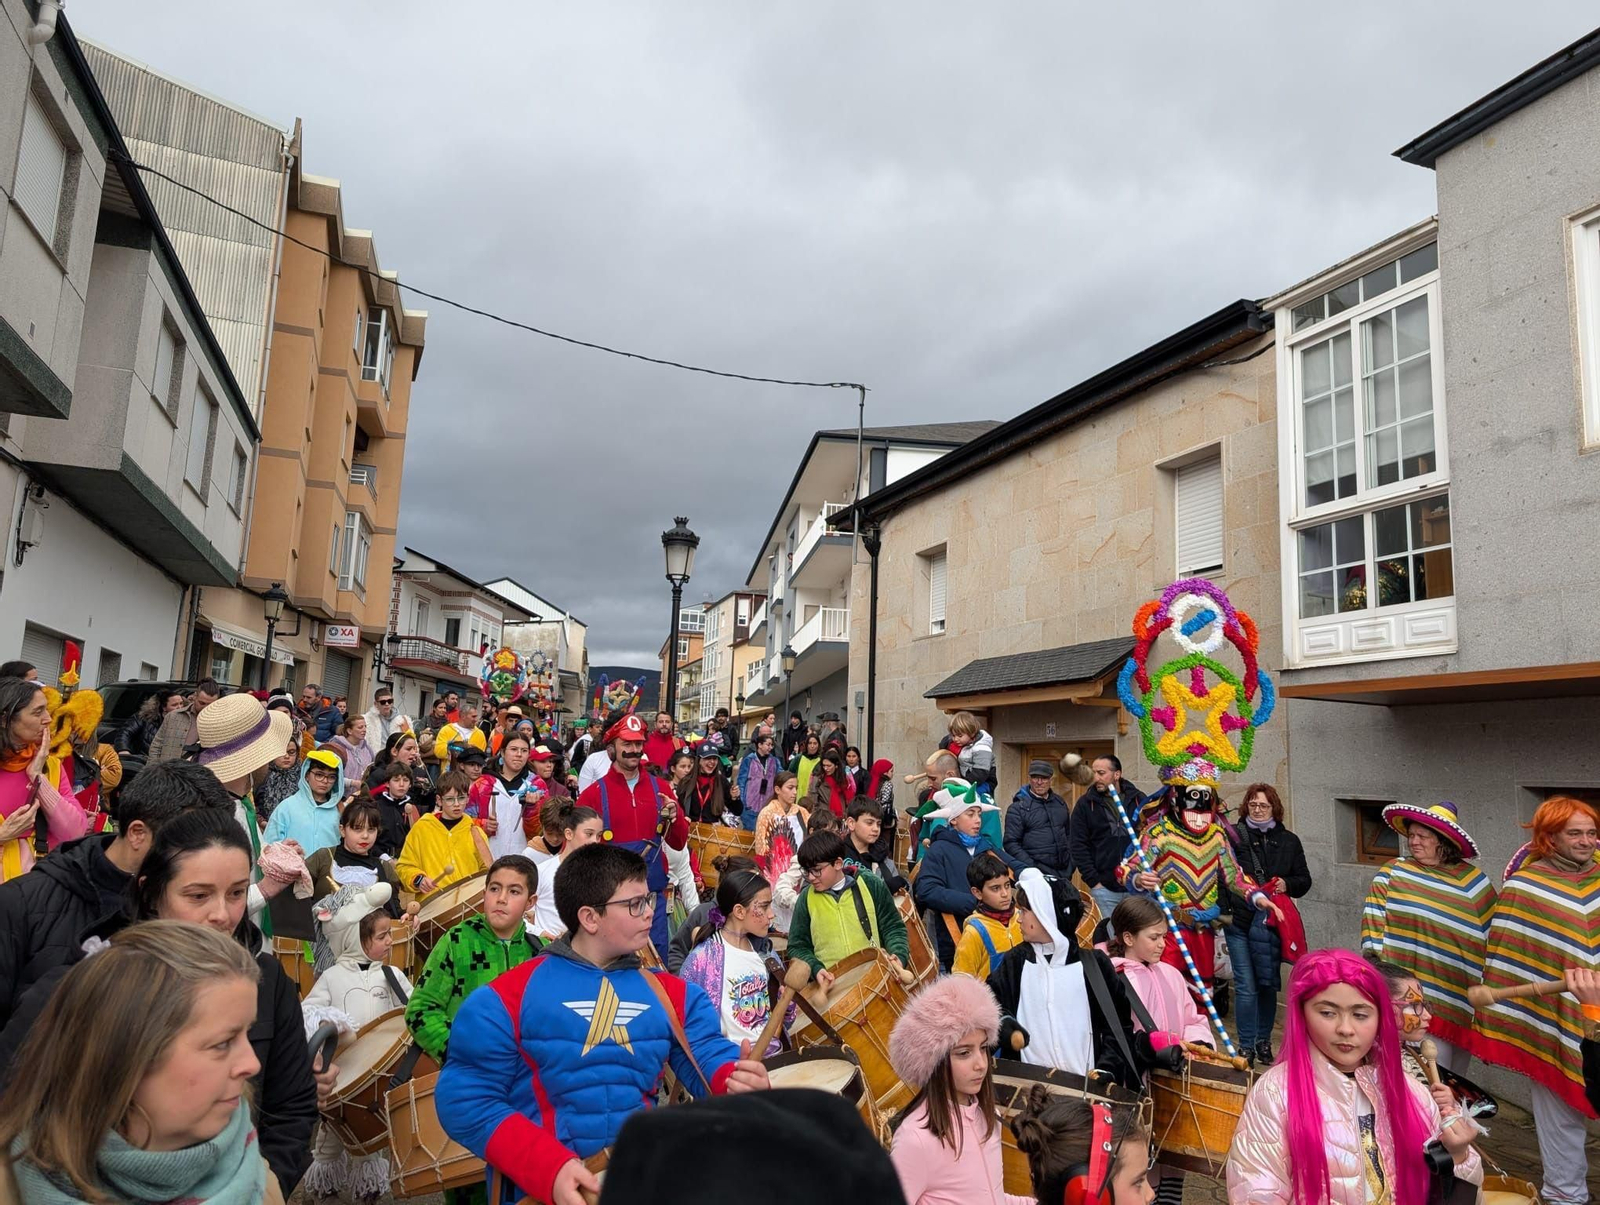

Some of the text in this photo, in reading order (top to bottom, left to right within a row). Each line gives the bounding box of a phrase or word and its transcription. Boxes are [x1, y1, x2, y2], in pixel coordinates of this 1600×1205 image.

[229, 637, 256, 653] COMERCIAL
[257, 646, 278, 660] GONLO
[733, 974, 767, 998] Totally
